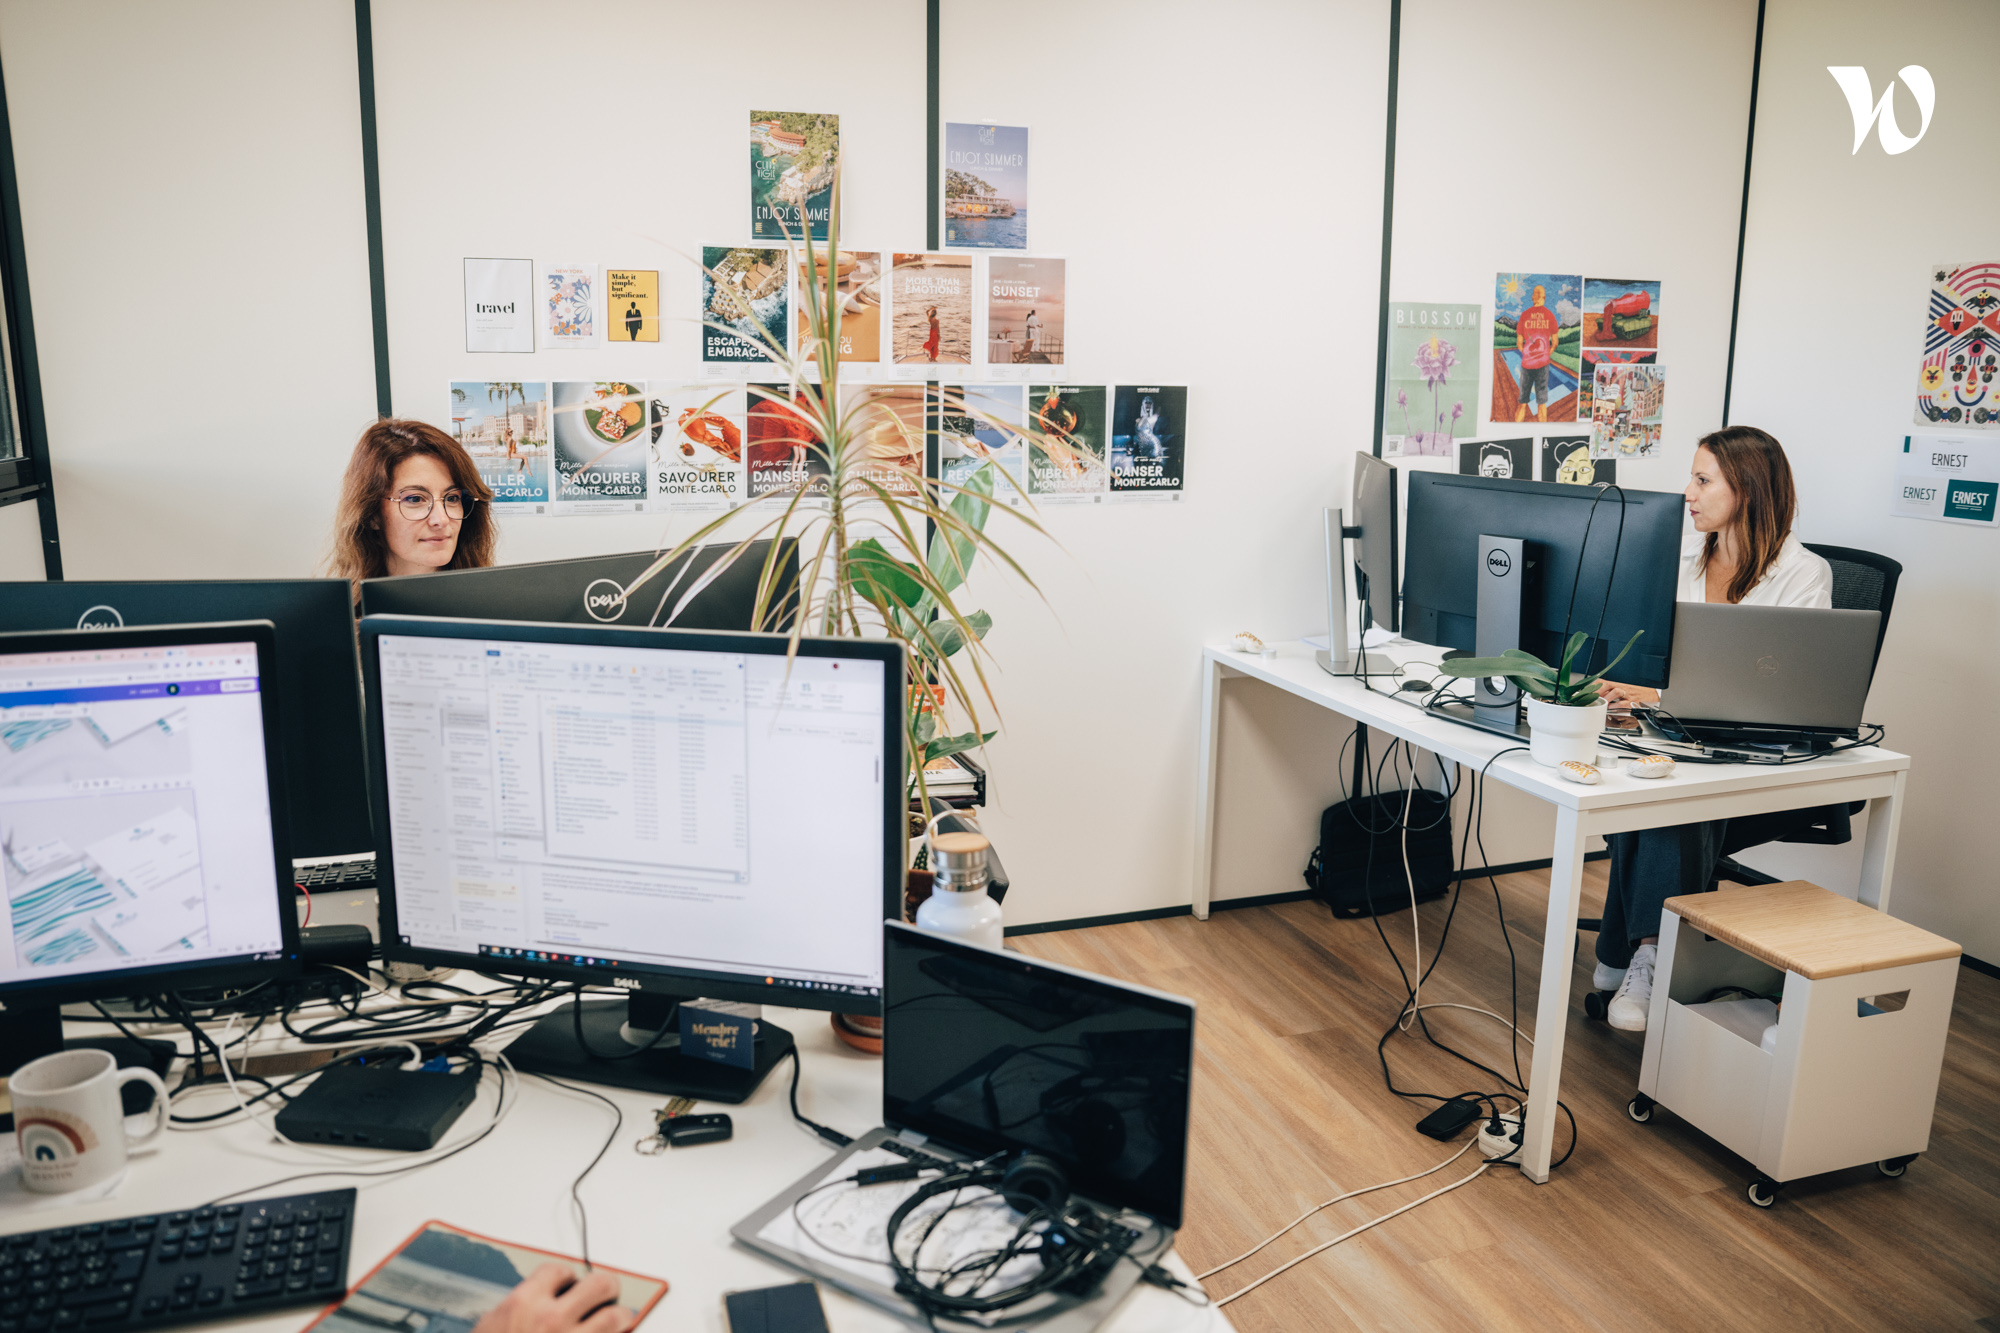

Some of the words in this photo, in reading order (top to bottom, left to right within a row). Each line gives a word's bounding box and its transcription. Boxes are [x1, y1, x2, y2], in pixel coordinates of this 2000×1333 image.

[950, 151, 980, 164] ENJOY
[984, 152, 1023, 167] SUMMER
[756, 206, 790, 220] ENJOY
[794, 207, 835, 221] SMME
[905, 277, 933, 286] MORE
[936, 277, 960, 287] THAN
[611, 292, 649, 300] significant.
[905, 285, 960, 295] EMOTIONS
[992, 286, 1041, 298] SUNSET
[475, 302, 516, 314] travel
[1396, 309, 1477, 326] BLOSSOM
[1530, 312, 1545, 320] MON
[707, 346, 766, 358] EMBRACE
[1931, 452, 1968, 467] ERNEST
[753, 470, 810, 483] DANSER
[1114, 465, 1163, 477] DANSER
[561, 472, 641, 485] SAVOURER
[659, 471, 736, 484] SAVOURER
[1113, 477, 1180, 487] MONTE-CARLO
[562, 485, 642, 496] MONTE-CARLO
[659, 484, 737, 495] MONTE-CARLO
[1903, 486, 1937, 501] ERNEST
[1952, 490, 1990, 506] ERNEST
[1489, 558, 1508, 567] DELL
[589, 593, 624, 608] DELL
[613, 977, 642, 990] DELL
